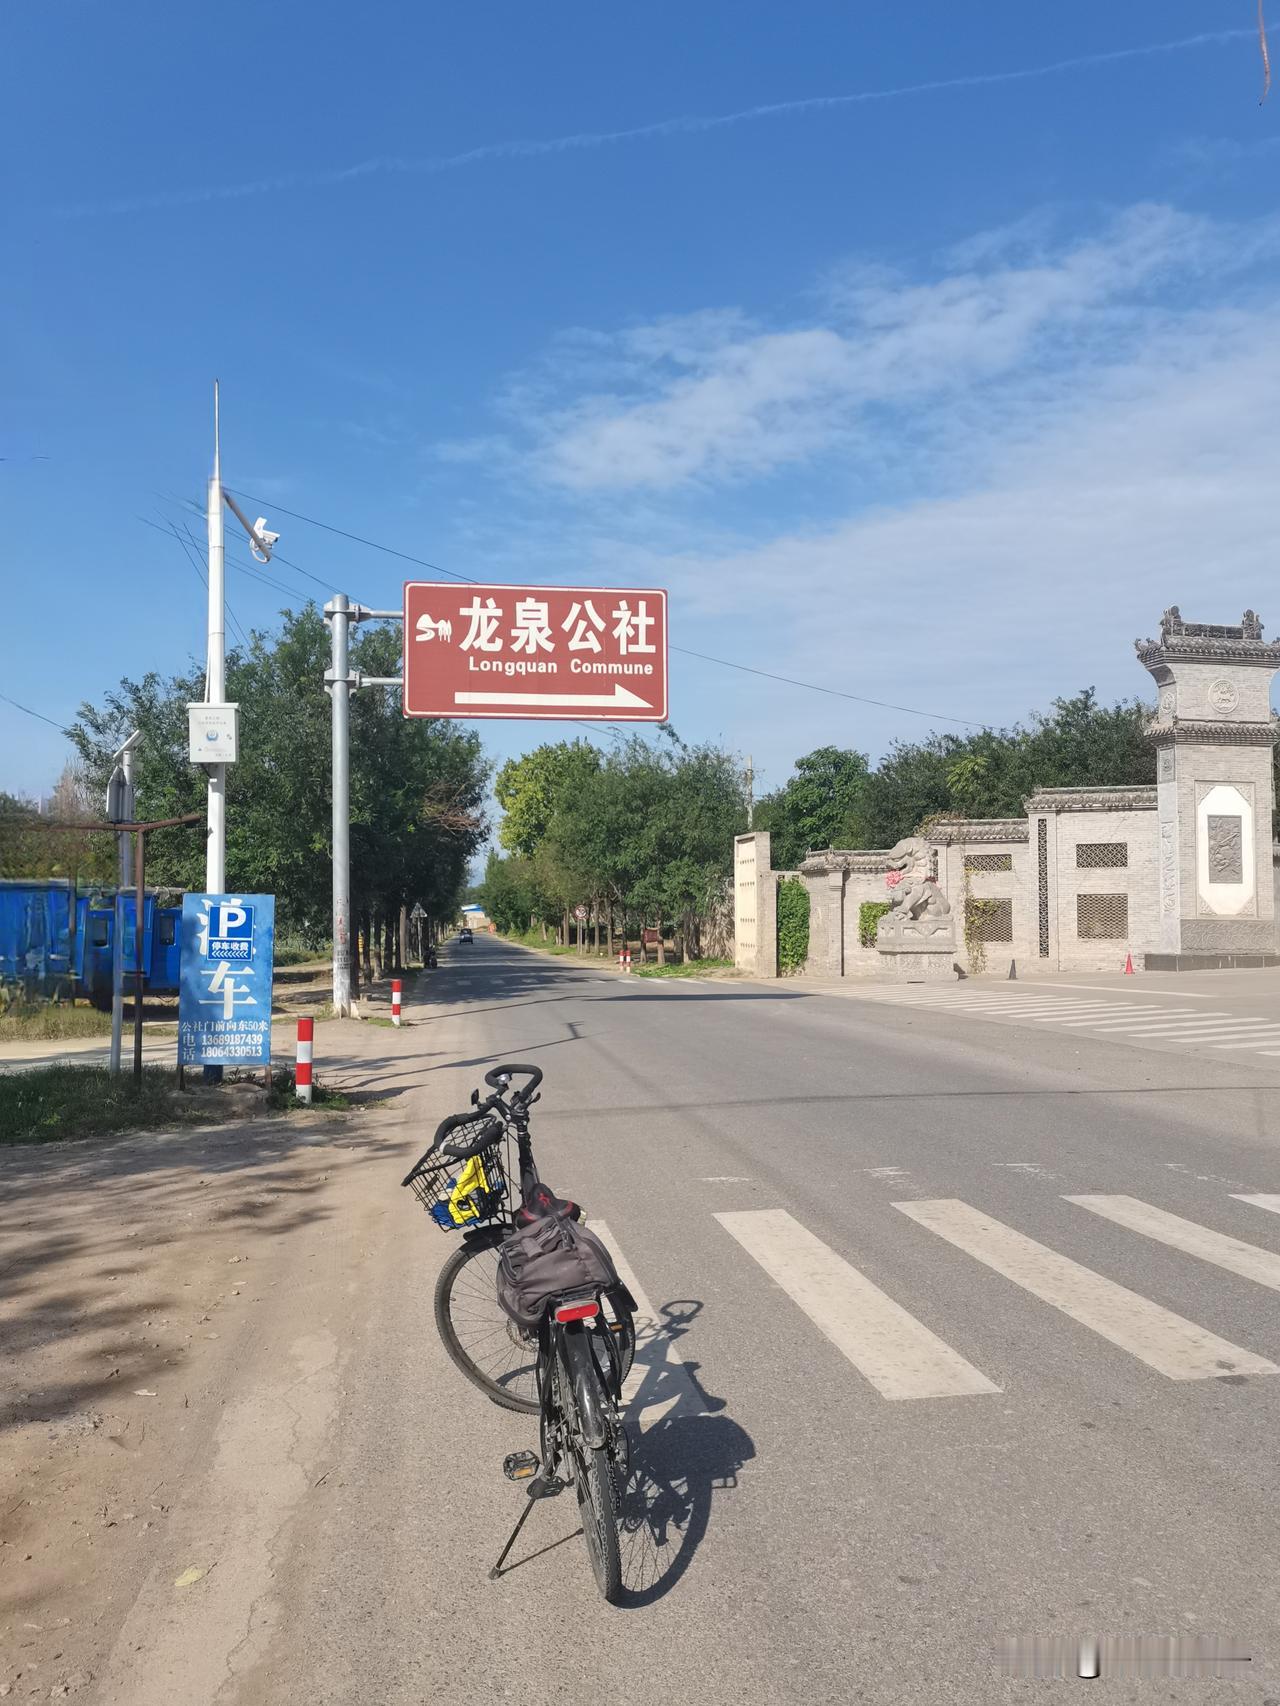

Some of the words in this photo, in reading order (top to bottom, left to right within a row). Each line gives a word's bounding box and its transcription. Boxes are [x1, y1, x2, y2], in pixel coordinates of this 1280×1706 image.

[459, 596, 656, 655] 龙泉公社
[469, 656, 557, 676] Longquan
[570, 659, 653, 675] Commune
[218, 907, 247, 937] P
[212, 941, 249, 951] 停车收费
